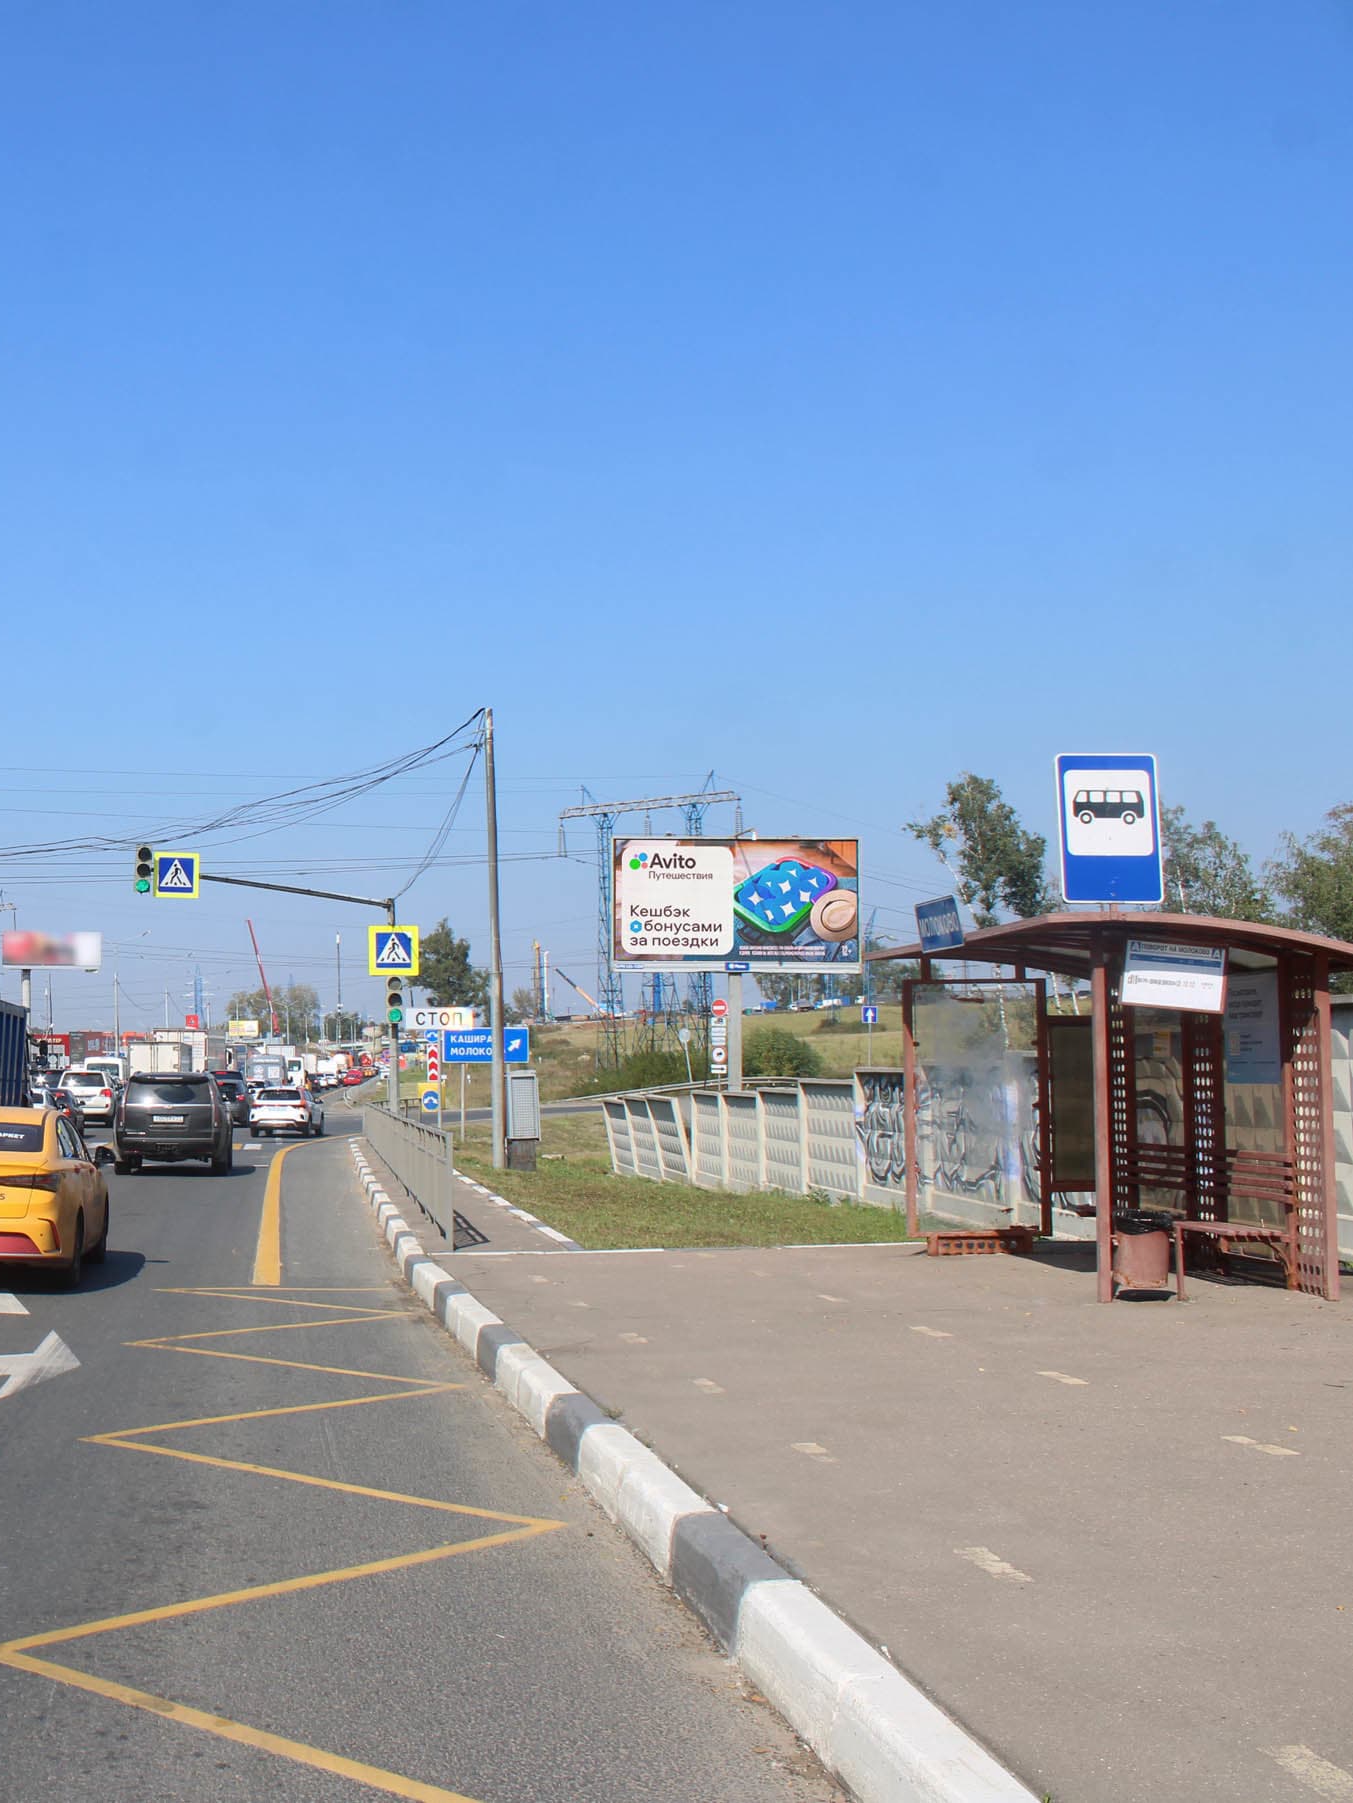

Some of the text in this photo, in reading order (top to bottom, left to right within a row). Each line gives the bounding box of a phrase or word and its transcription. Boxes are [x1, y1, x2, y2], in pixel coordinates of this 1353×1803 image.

[649, 853, 696, 869] Avito
[648, 871, 713, 881] Путешествия
[630, 905, 691, 918] Кешбэк
[644, 920, 723, 935] бонусами
[630, 937, 719, 948] за поездки
[416, 1012, 462, 1026] СТОП
[450, 1046, 494, 1056] МОЛОКО
